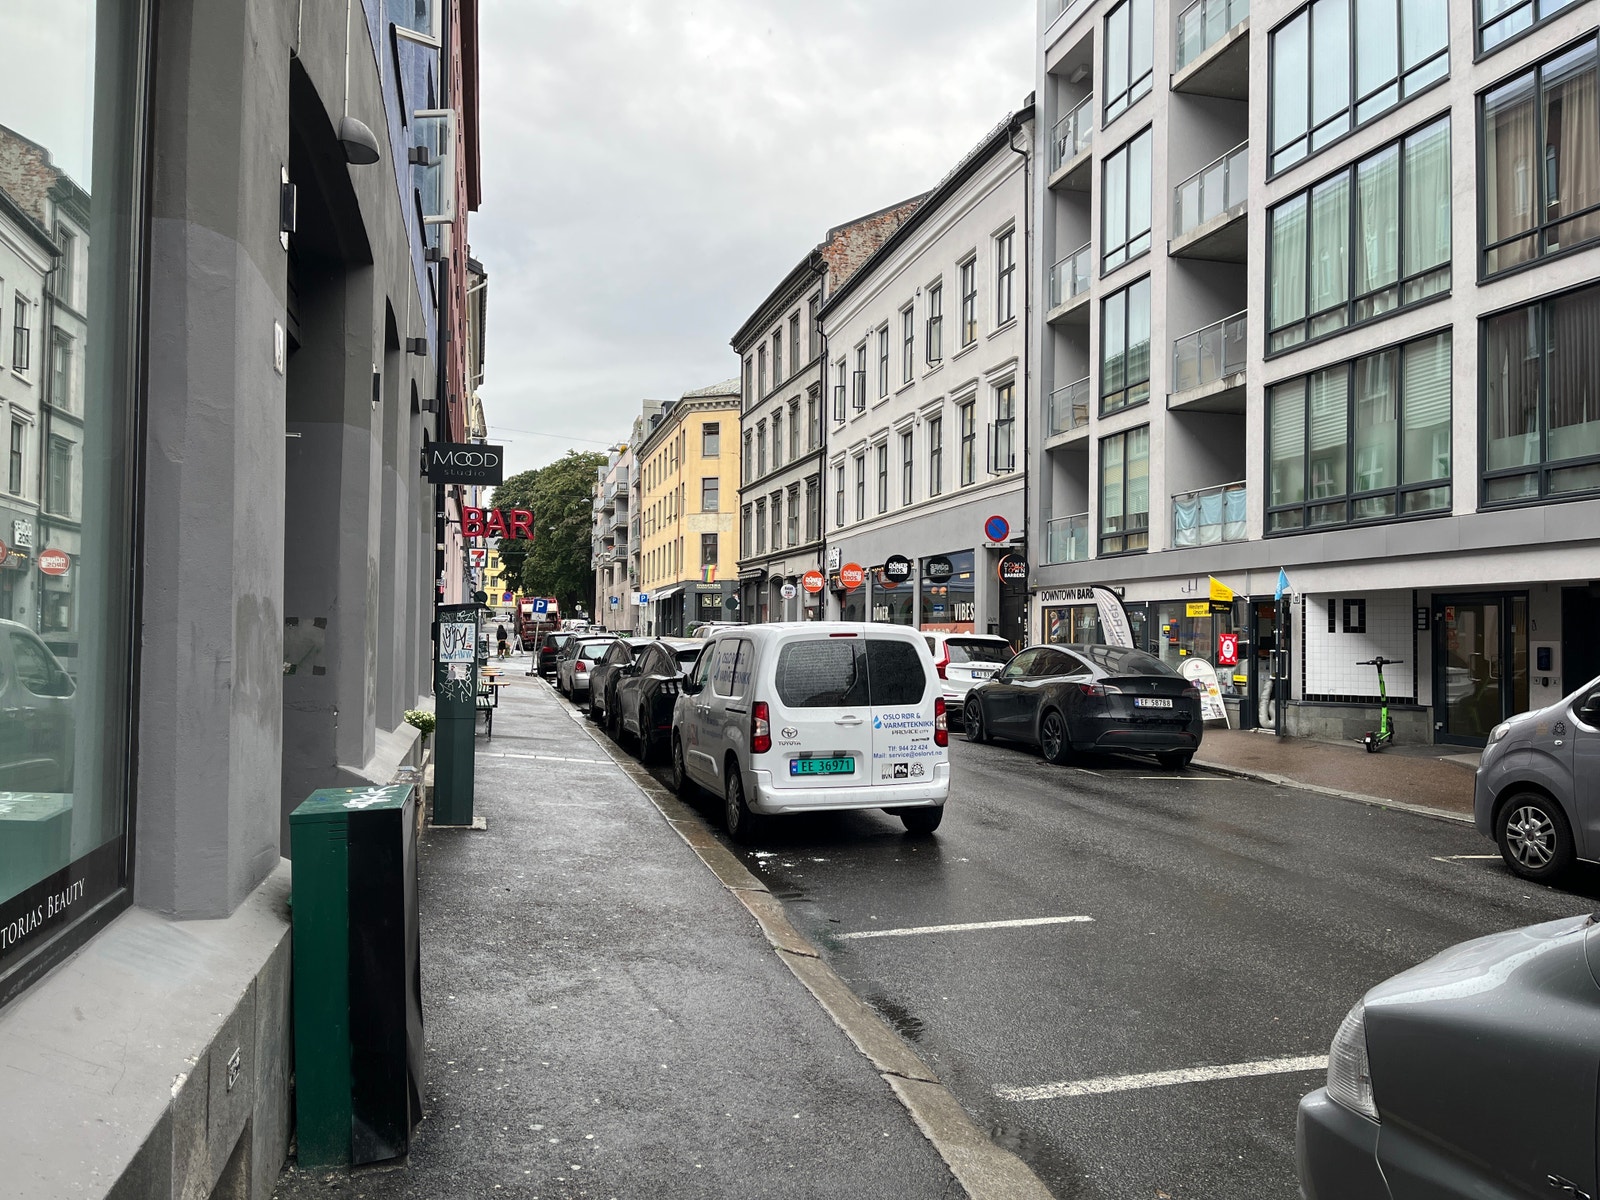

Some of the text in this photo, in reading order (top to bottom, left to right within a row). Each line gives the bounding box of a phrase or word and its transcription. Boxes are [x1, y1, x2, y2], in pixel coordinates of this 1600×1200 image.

[433, 450, 498, 468] MOOD
[462, 506, 534, 540] BAR
[1042, 588, 1076, 602] DOWNTOWN
[536, 600, 544, 611] P
[954, 602, 974, 621] VIBES
[802, 760, 850, 771] EE 36971
[48, 878, 85, 918] BEAUTY
